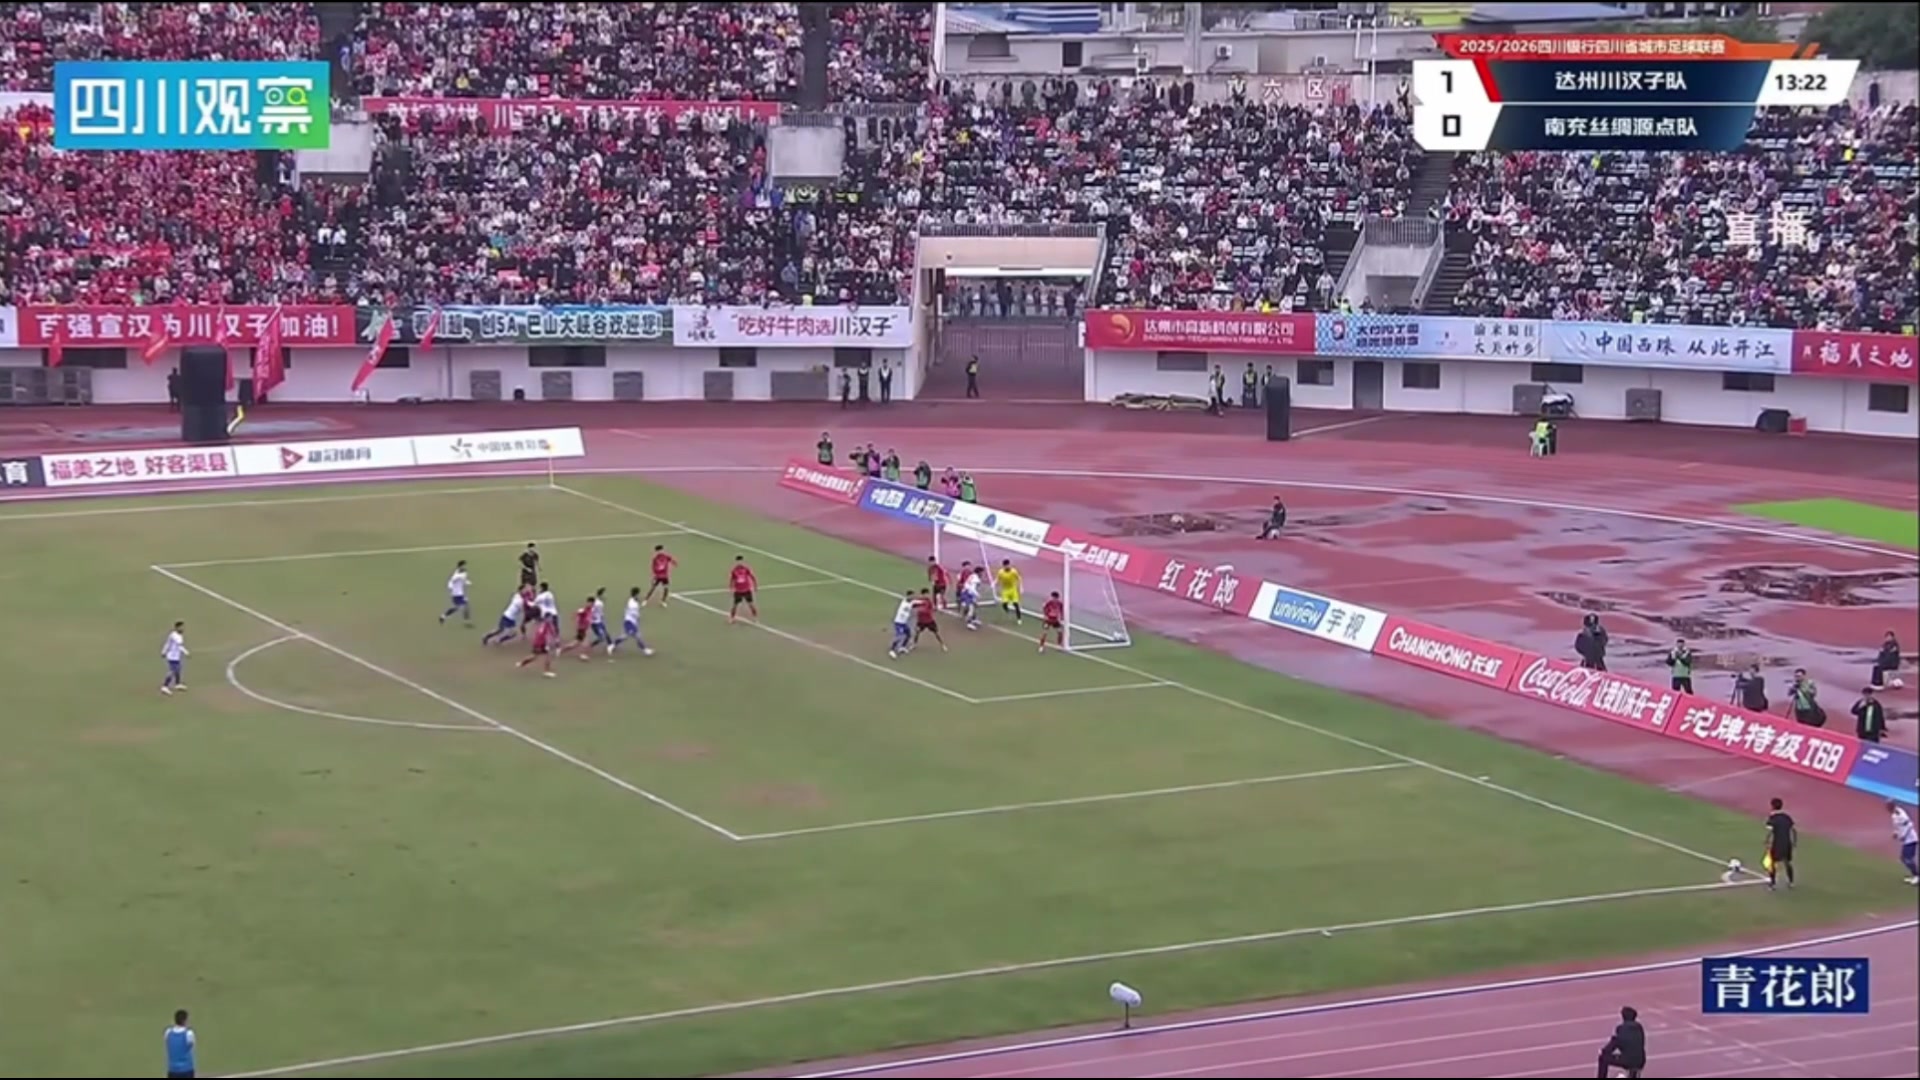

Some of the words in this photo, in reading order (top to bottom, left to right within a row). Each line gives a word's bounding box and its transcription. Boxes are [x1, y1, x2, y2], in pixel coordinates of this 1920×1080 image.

[50, 457, 138, 481] 福美之地
[144, 451, 229, 476] 好客渠县
[1158, 559, 1239, 606] 红花郎
[1273, 600, 1323, 627] uniview
[1325, 607, 1366, 641] 宇视
[1389, 626, 1472, 672] CHANGHONG
[1470, 650, 1503, 678] 长虹
